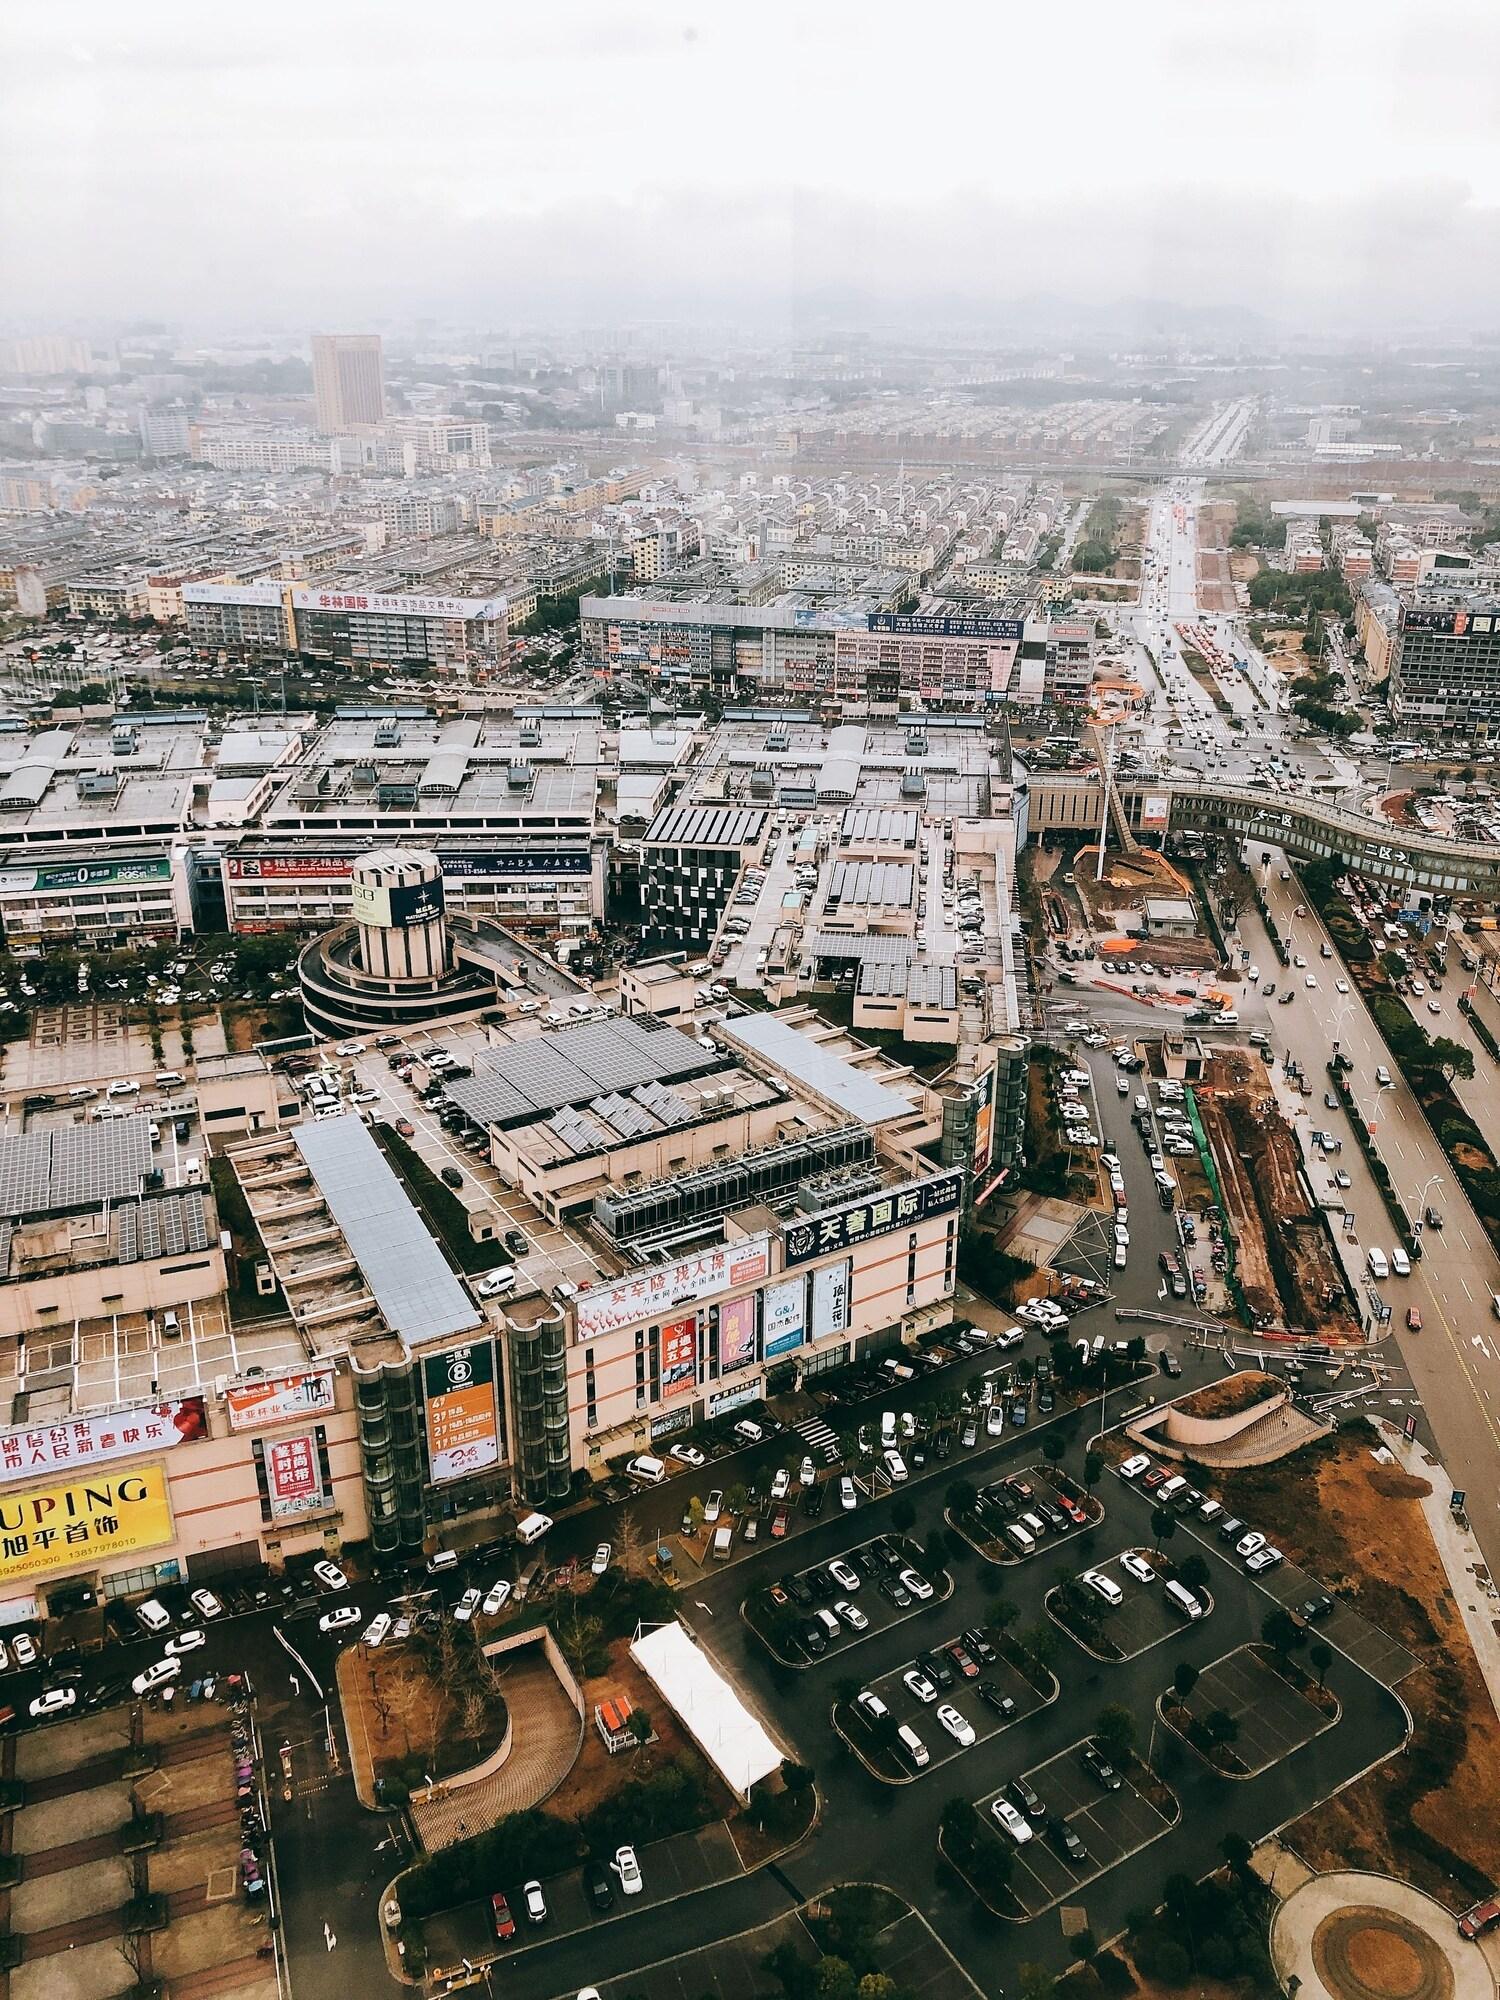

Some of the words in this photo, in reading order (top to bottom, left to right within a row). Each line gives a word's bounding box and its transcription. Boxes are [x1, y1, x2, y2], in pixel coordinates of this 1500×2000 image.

[452, 1362, 468, 1382] 8
[1, 1515, 119, 1560] 旭平首饰
